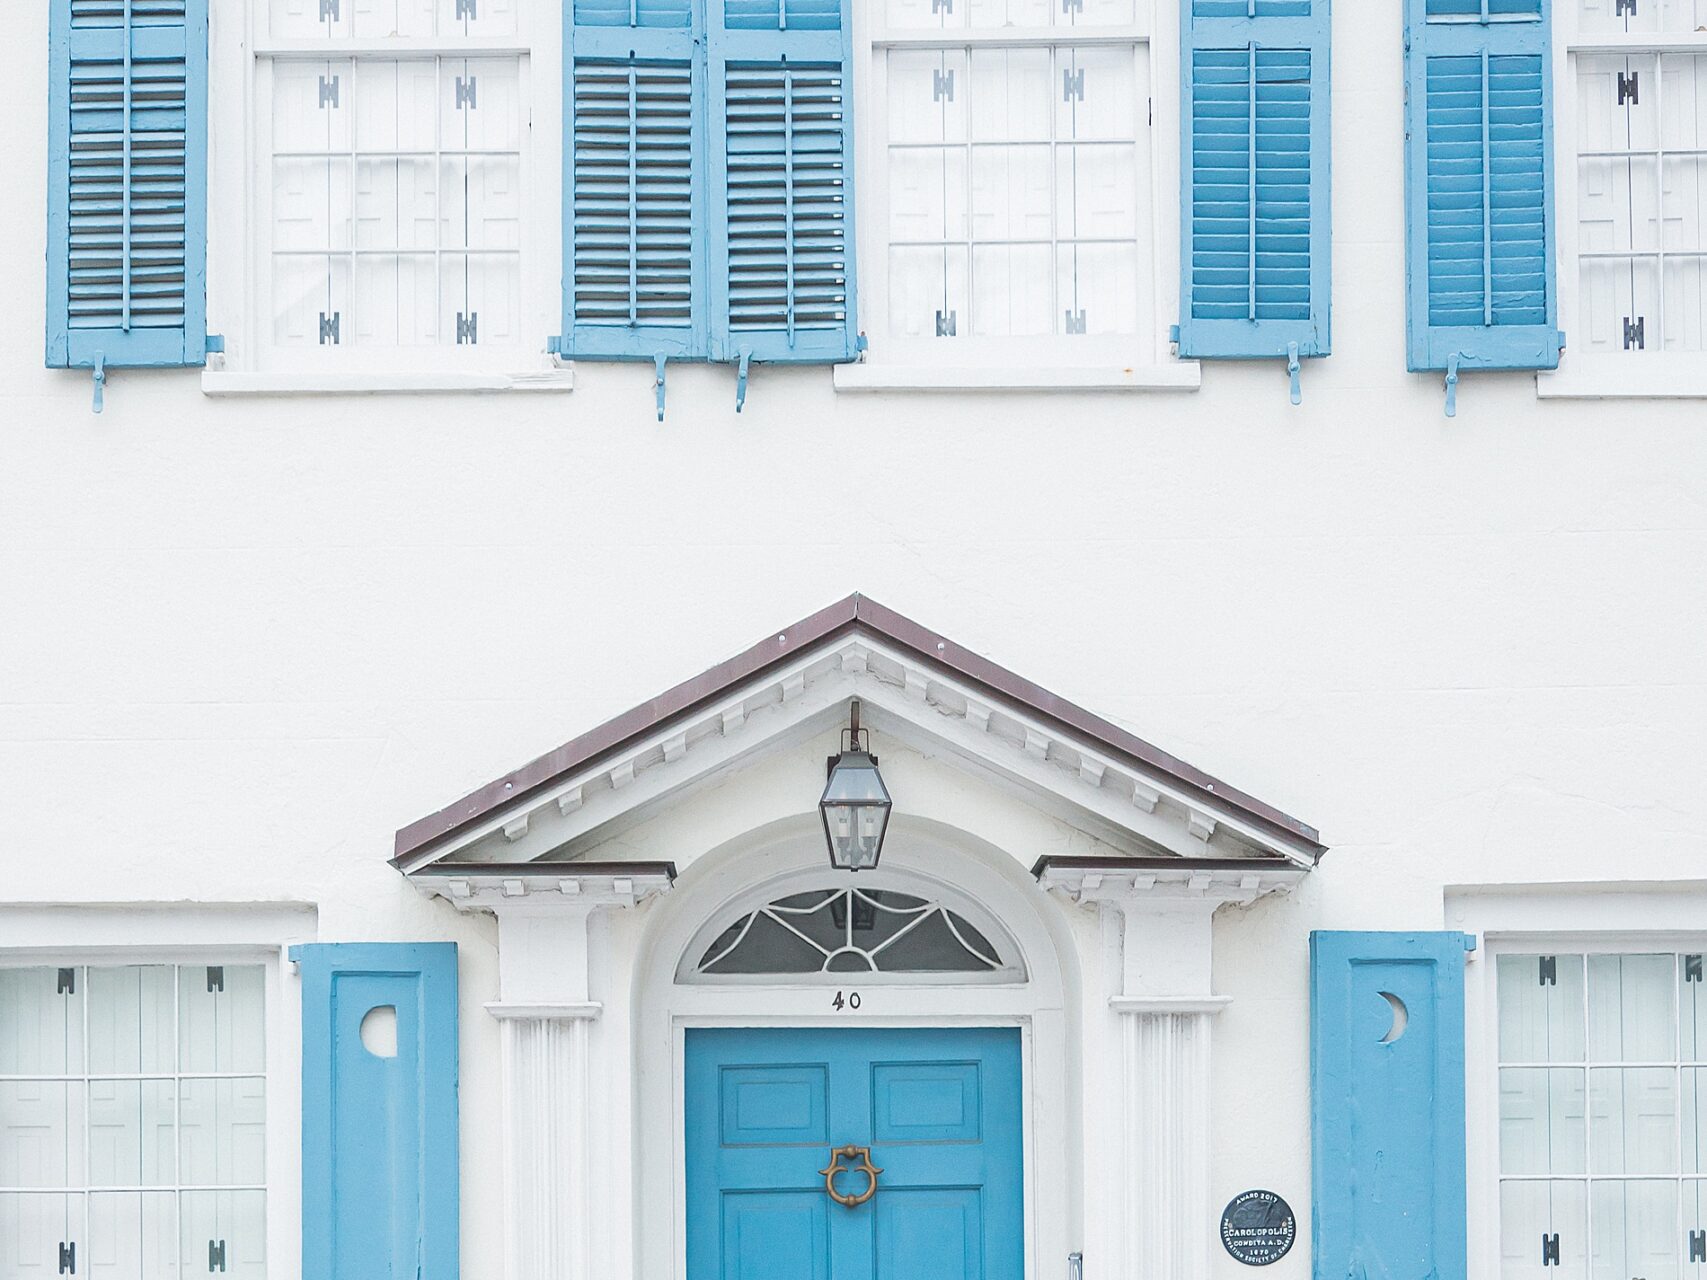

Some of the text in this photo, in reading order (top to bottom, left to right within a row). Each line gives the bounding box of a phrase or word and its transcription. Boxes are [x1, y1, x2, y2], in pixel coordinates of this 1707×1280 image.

[832, 991, 861, 1011] 40
[1236, 1192, 1278, 1205] AWARD 2017
[1228, 1227, 1288, 1237] CAROLOPOLIS
[1245, 1255, 1270, 1263] SOCIETY
[1270, 1252, 1278, 1260] OF
